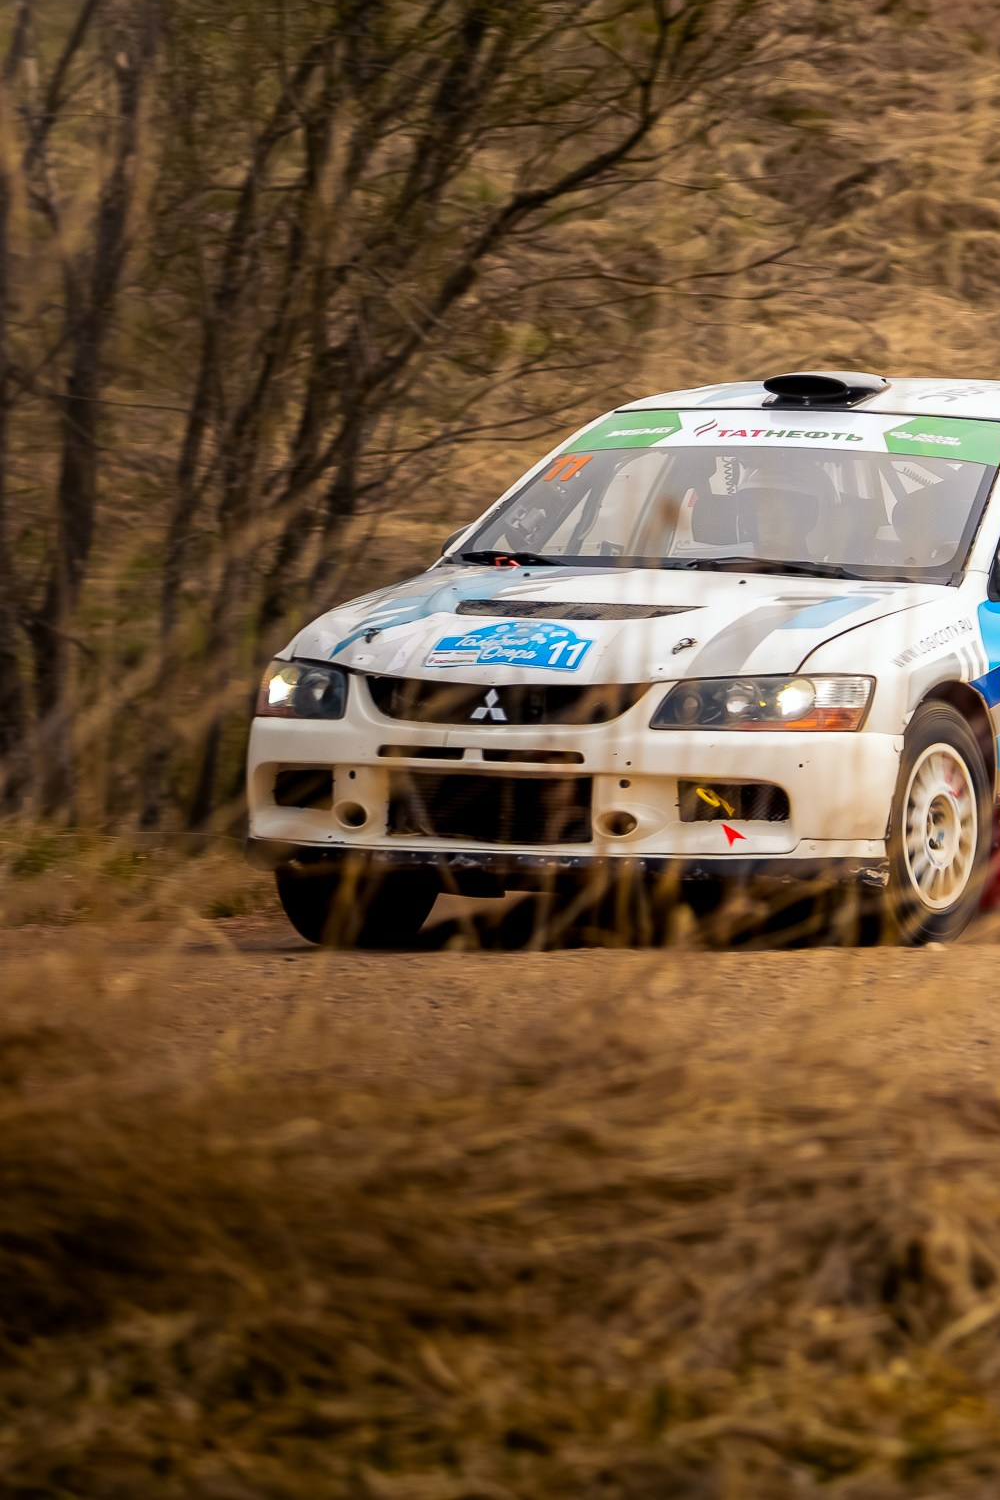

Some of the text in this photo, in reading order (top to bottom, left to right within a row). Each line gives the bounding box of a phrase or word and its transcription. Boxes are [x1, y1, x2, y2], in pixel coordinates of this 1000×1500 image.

[717, 429, 864, 441] ТАТНЕФТЬ
[544, 455, 593, 482] 11
[548, 640, 586, 666] 11
